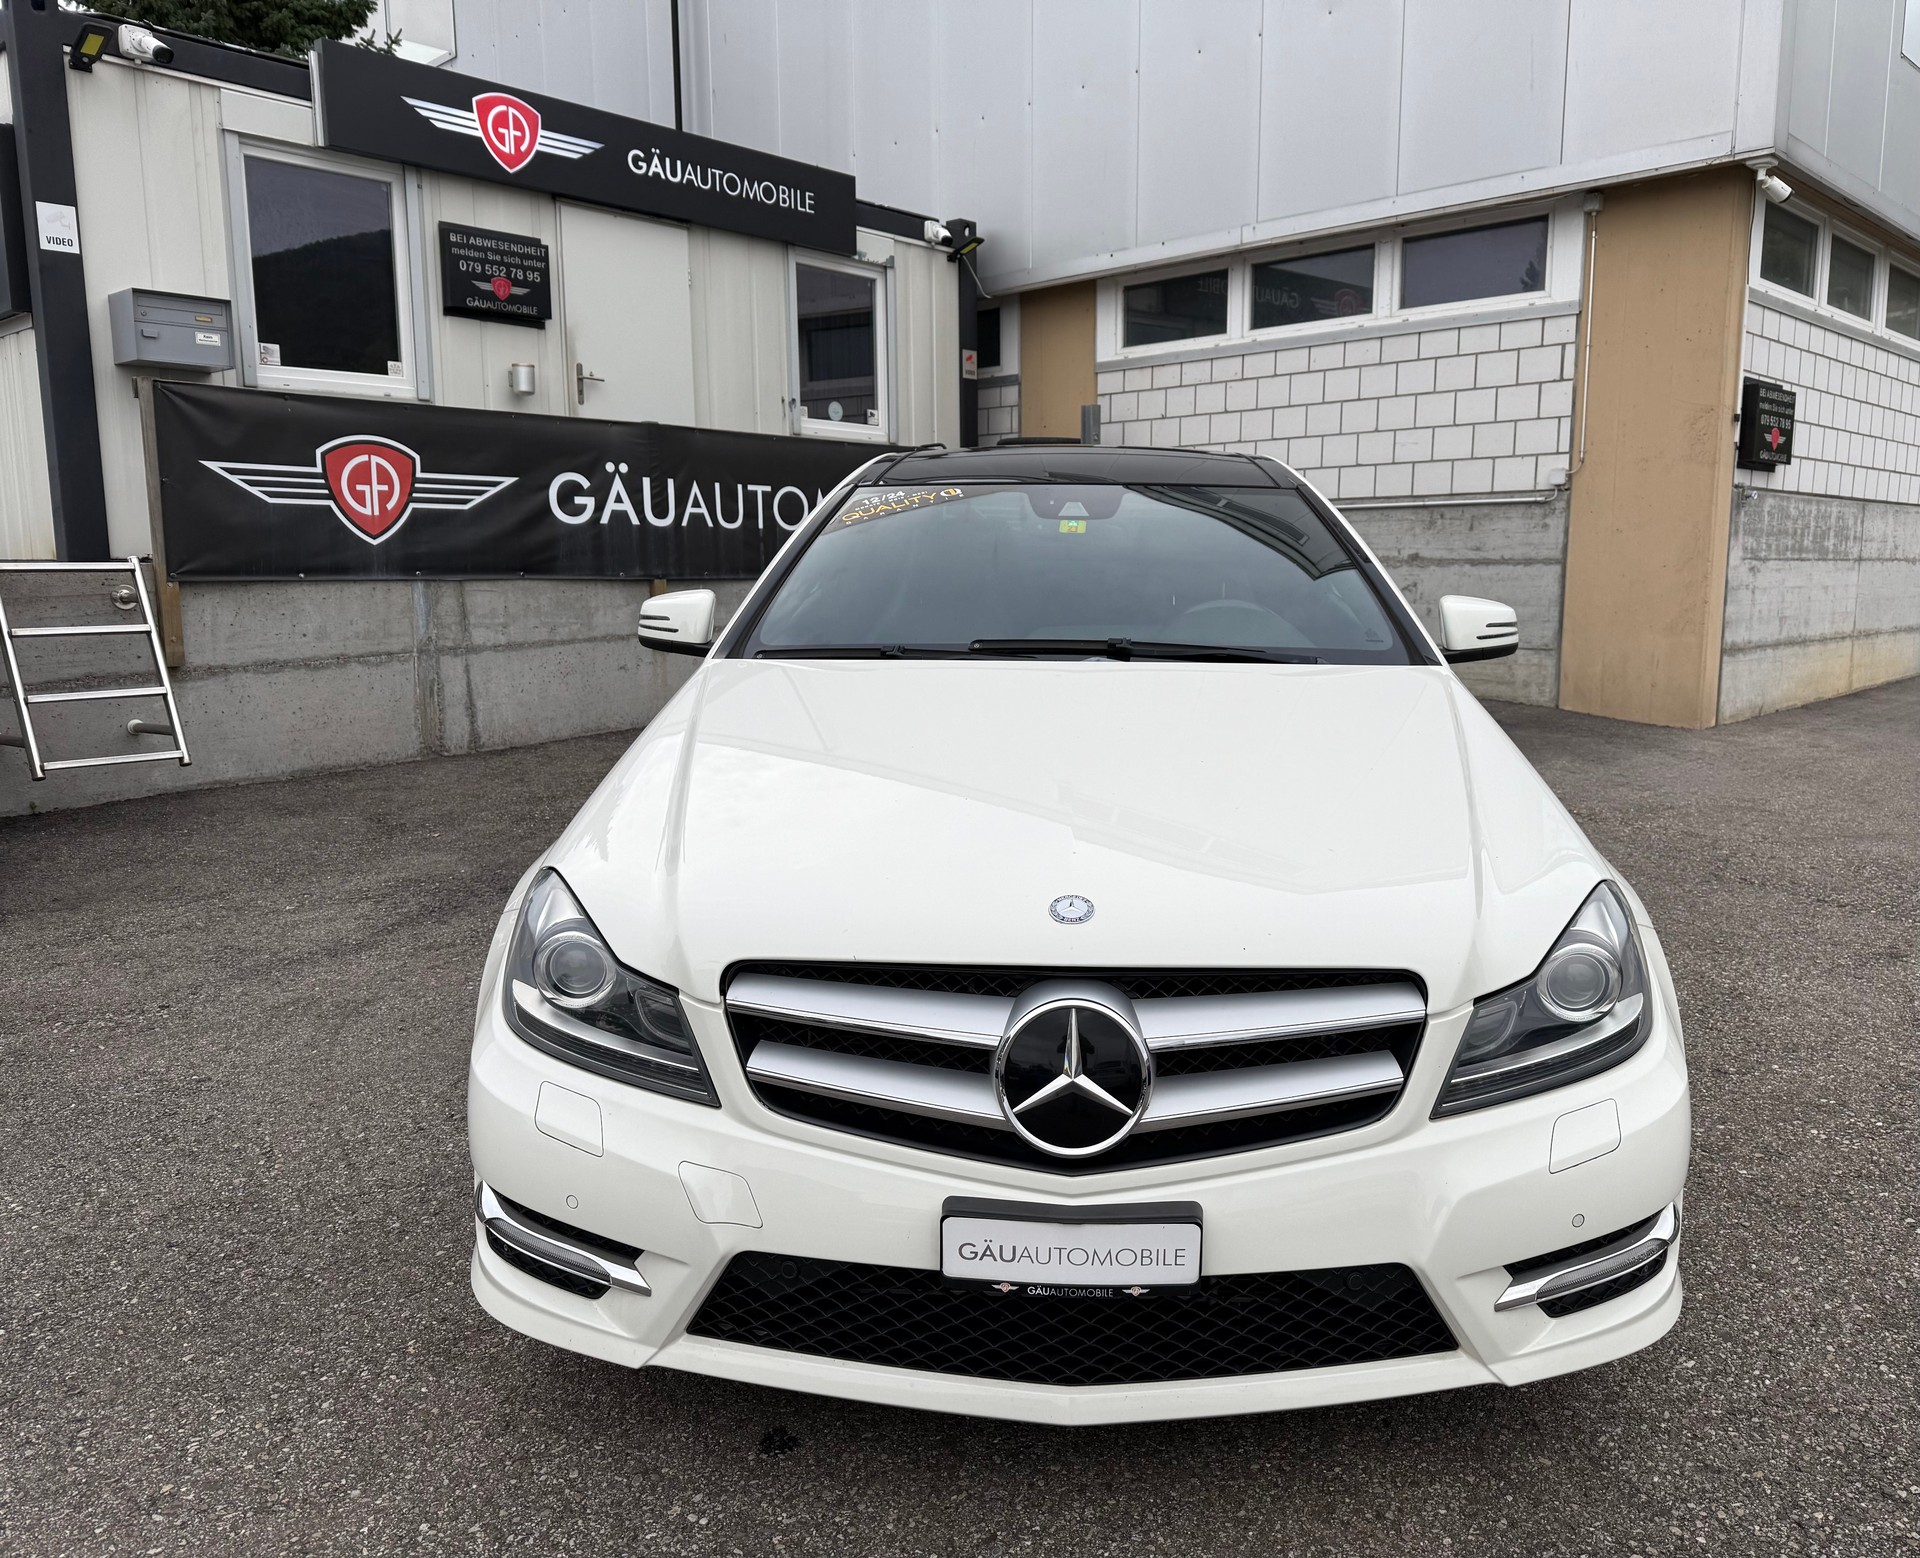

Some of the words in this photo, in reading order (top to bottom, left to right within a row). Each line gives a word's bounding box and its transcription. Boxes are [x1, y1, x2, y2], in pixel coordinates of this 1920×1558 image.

[627, 147, 815, 213] GÄUAUTOMOBILE
[45, 235, 73, 247] VIDEO
[449, 232, 467, 243] BEI
[469, 236, 546, 257] ABWESENDHEIT
[451, 247, 485, 259] melden
[487, 251, 501, 262] Sie
[503, 254, 521, 264] sich
[523, 259, 546, 268] unter
[459, 260, 482, 273] 079
[485, 264, 507, 277] 552
[510, 267, 524, 280] 78
[526, 270, 541, 283] 95
[466, 296, 538, 315] GÄUAUTOMOBILE
[548, 461, 824, 532] GÄUAUTO
[841, 492, 937, 521] QUALITY
[862, 490, 906, 505] 12/24
[958, 1239, 1186, 1267] GÄUAUTOMOBILE
[1027, 1285, 1114, 1298] GÄUAUTOMOBILE
